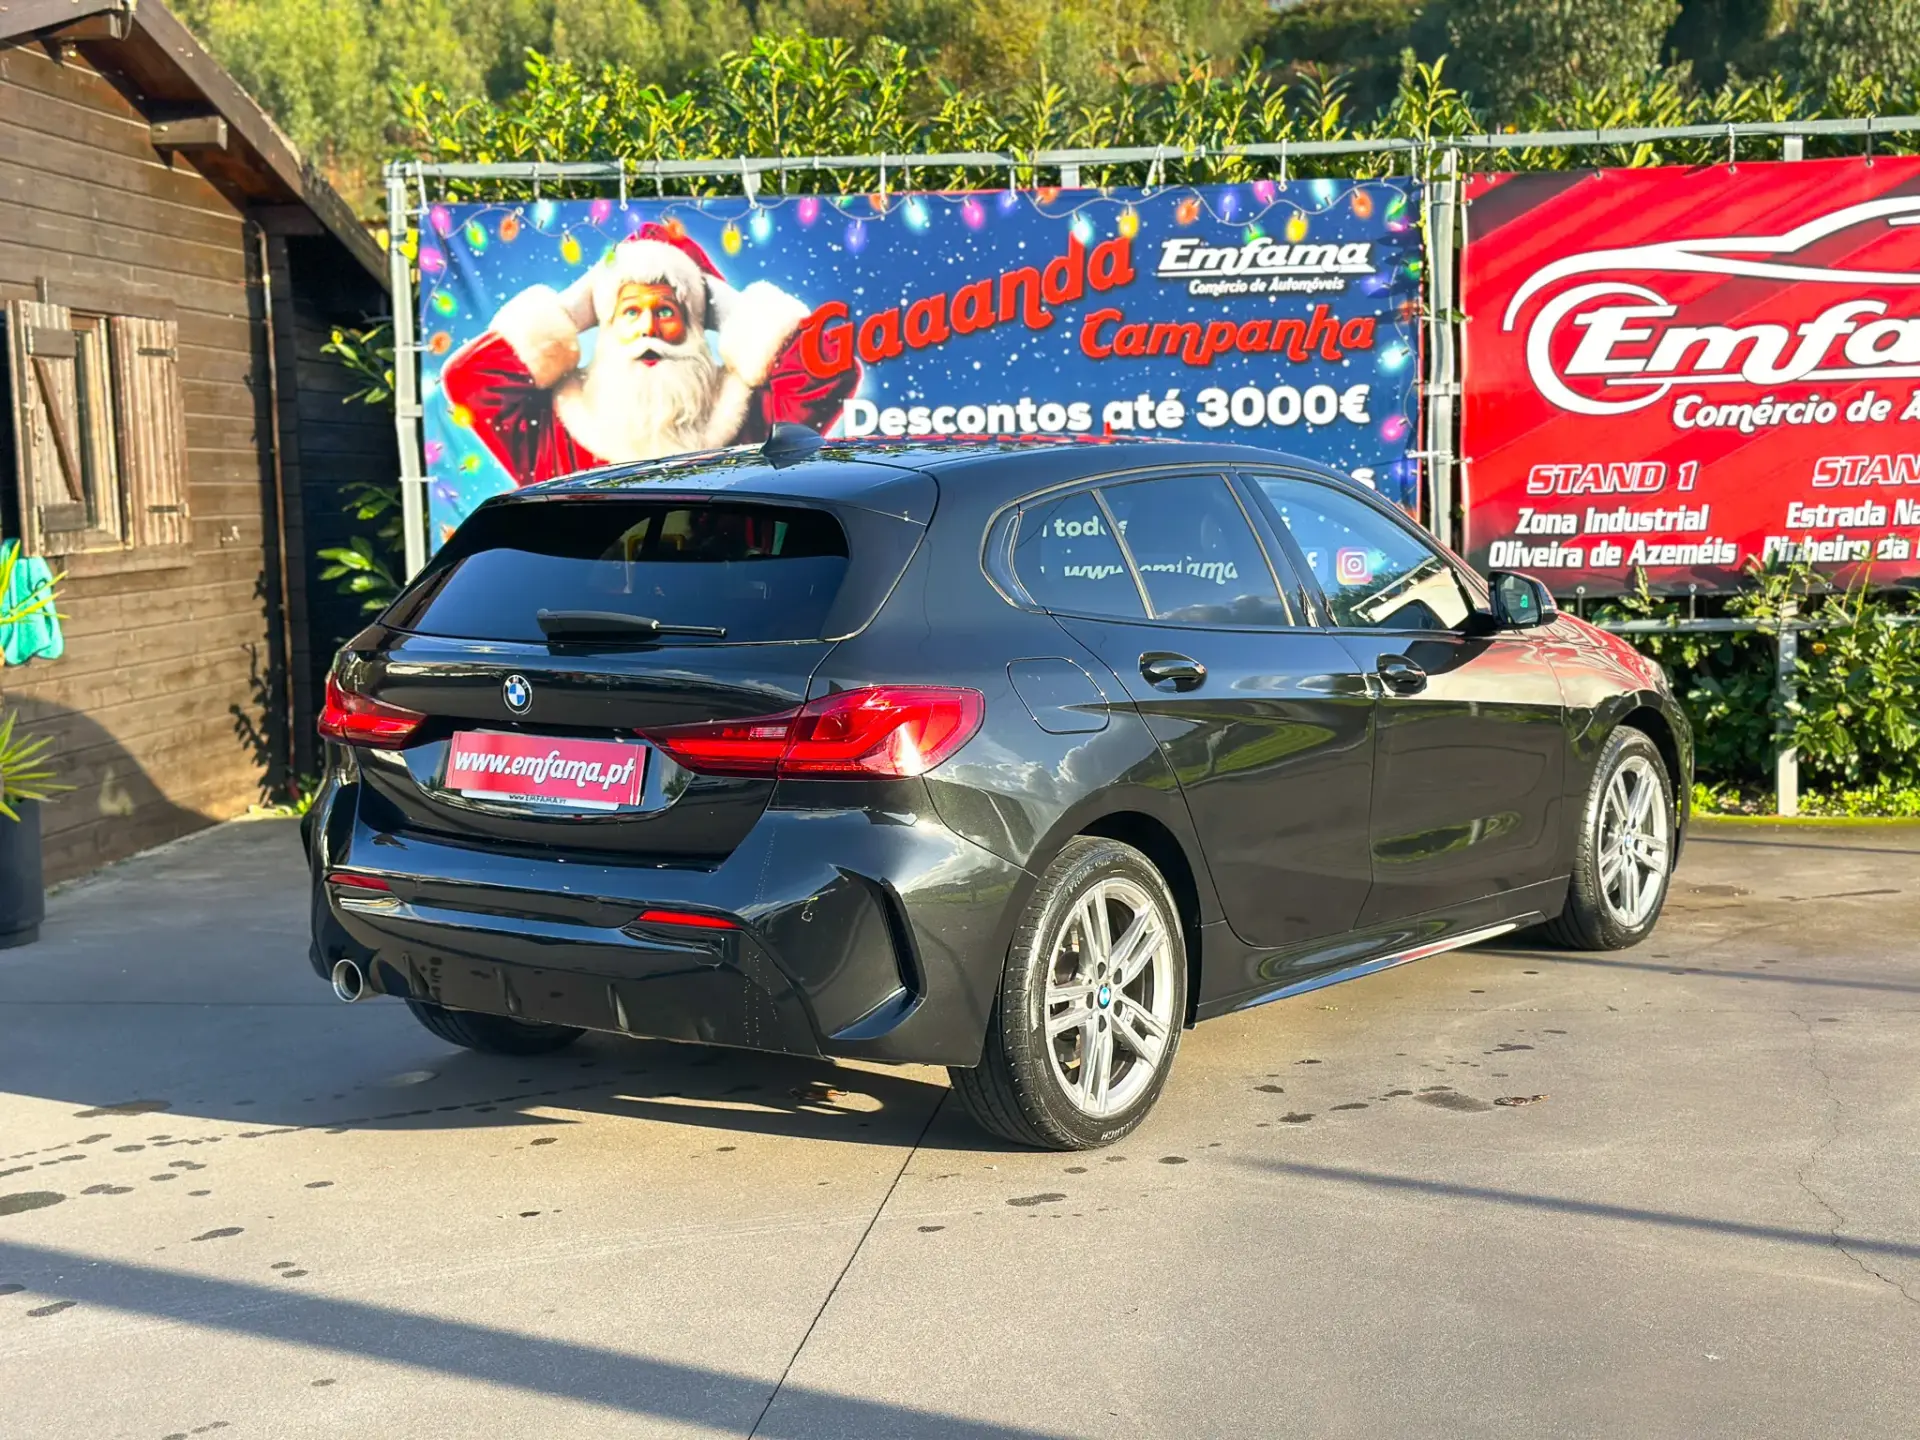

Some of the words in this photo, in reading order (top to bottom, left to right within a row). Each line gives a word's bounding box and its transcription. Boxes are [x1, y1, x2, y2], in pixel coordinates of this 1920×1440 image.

[1158, 236, 1372, 275] Emfama
[1250, 279, 1266, 292] de
[799, 230, 1135, 378] Gaaanda
[1080, 303, 1376, 366] Campanha
[842, 399, 1092, 436] Descontos
[1104, 396, 1184, 431] até
[1196, 384, 1370, 428] 3000€
[1672, 394, 1838, 434] Comércio
[1845, 390, 1892, 422] de
[1526, 462, 1666, 496] STAND
[1677, 461, 1699, 490] 1
[1812, 454, 1920, 487] STAN
[1514, 506, 1578, 536] Zona
[1585, 504, 1709, 534] Industrial
[1785, 500, 1888, 529] Estrada
[1488, 543, 1584, 569] Oliveira
[1589, 540, 1622, 567] de
[1630, 538, 1738, 567] Azeméis
[1876, 534, 1911, 560] da
[454, 749, 635, 791] www.emfama.pt
